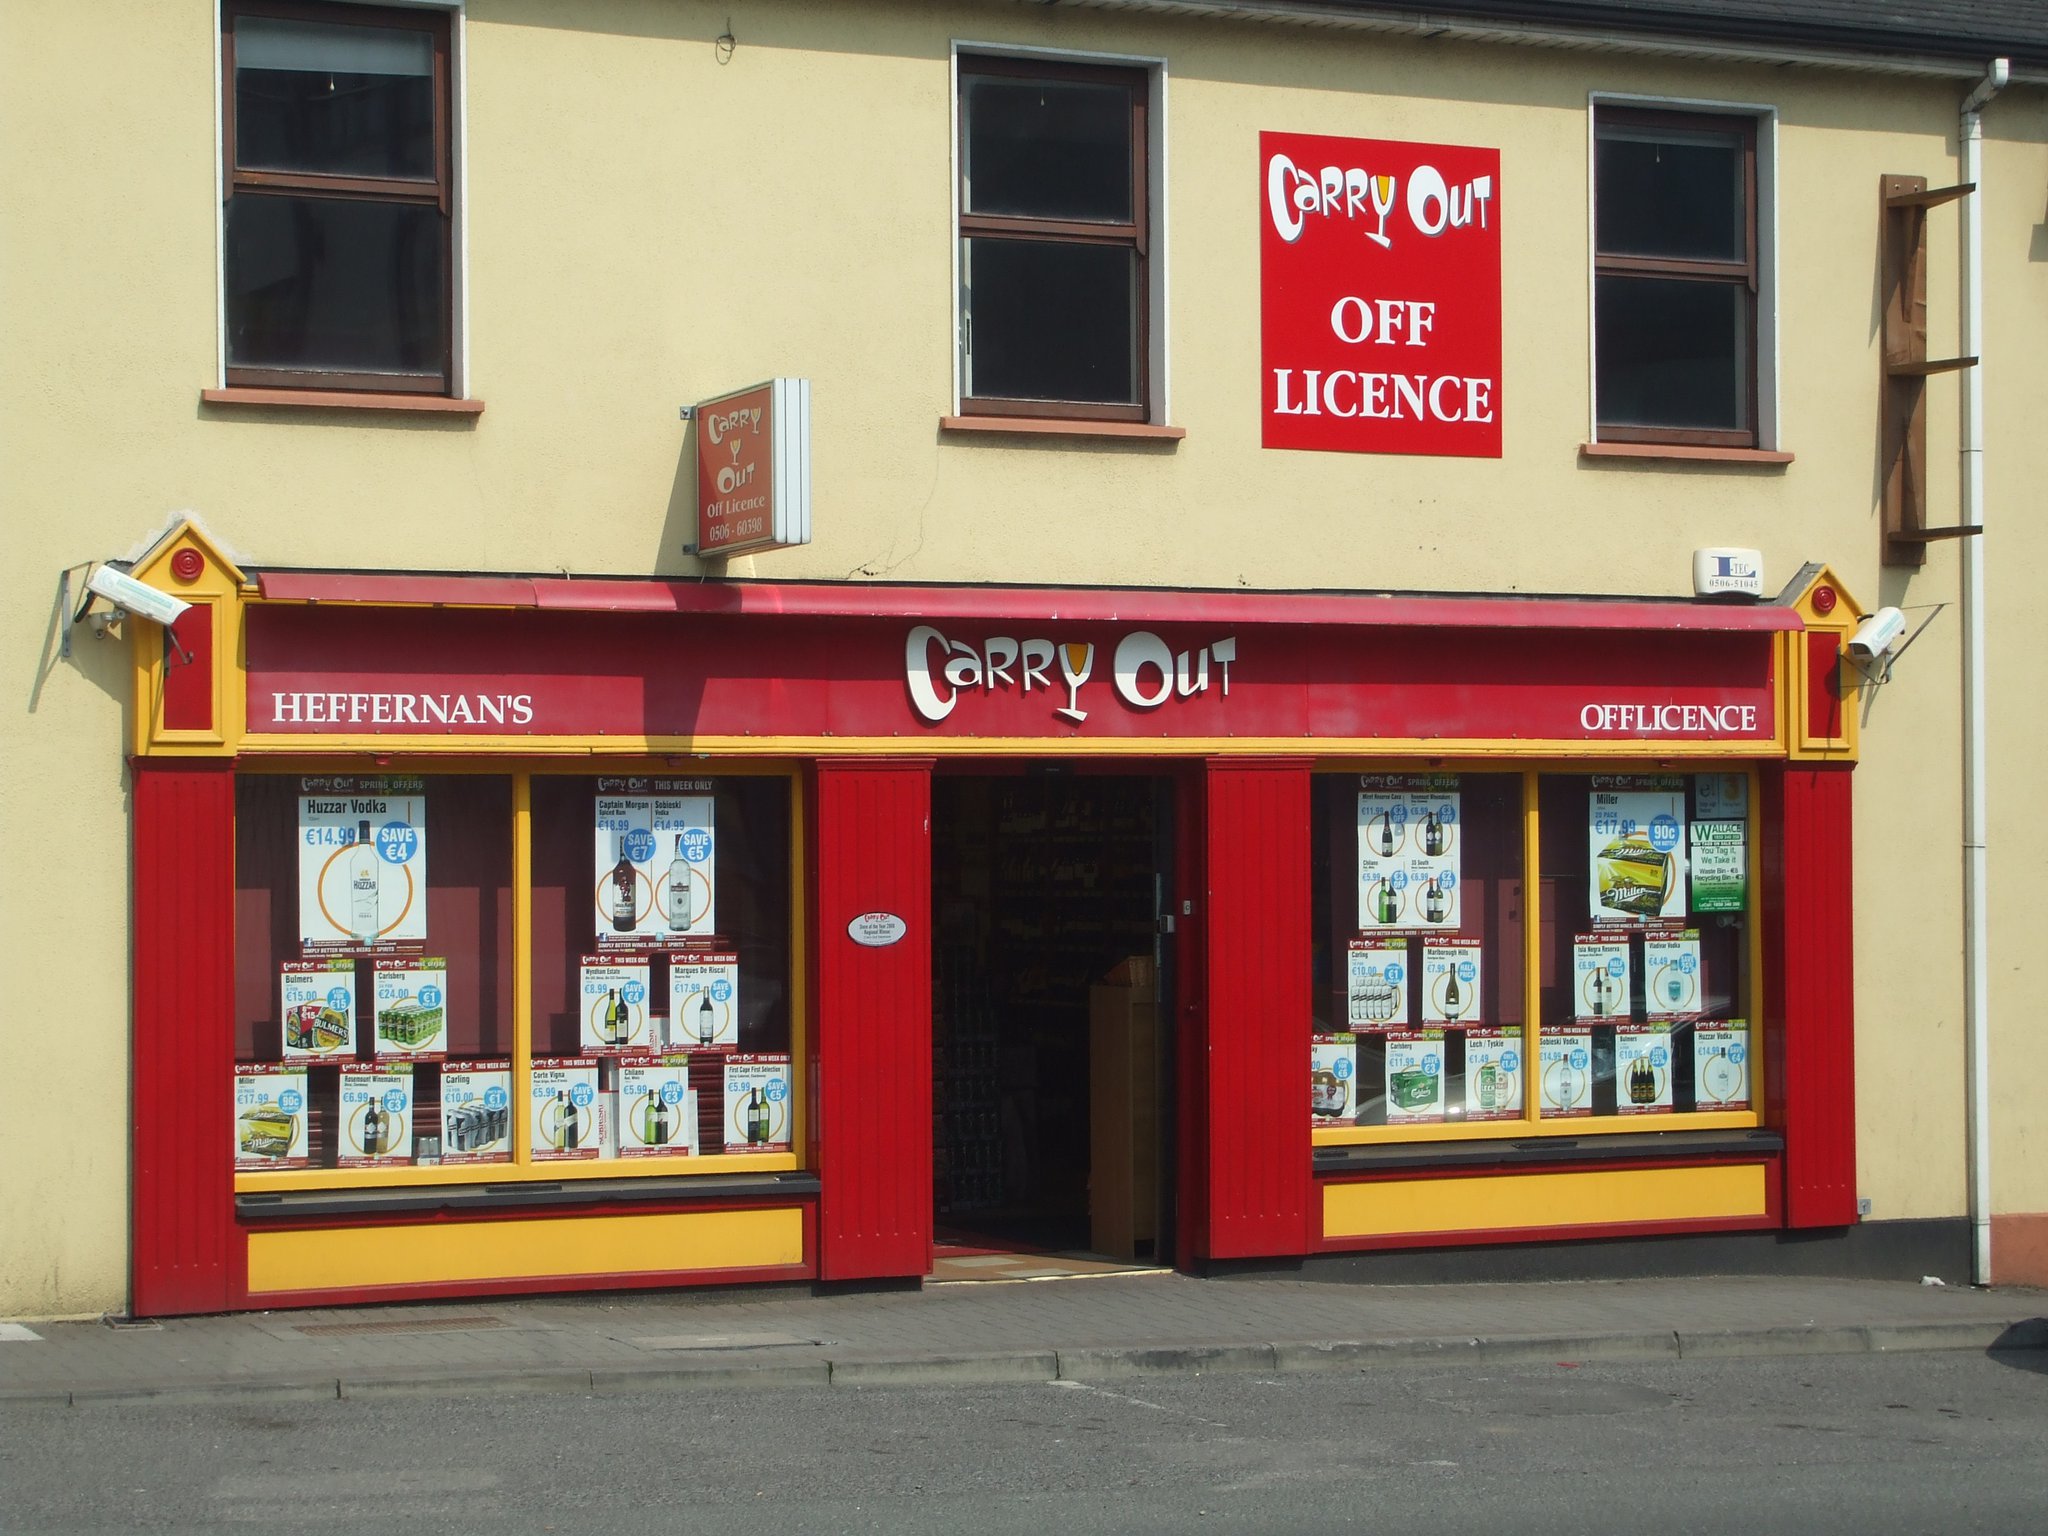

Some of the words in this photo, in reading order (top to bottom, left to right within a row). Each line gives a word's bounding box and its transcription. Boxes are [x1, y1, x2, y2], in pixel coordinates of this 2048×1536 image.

[1330, 295, 1435, 347] OFF
[1273, 368, 1494, 423] LICENCE
[707, 501, 723, 518] Off
[726, 496, 765, 515] Licence
[709, 523, 730, 542] 0506
[272, 692, 533, 724] HEFFERNAN'S
[1580, 704, 1757, 731] OFFLICENCE
[360, 780, 388, 789] SPRING
[393, 780, 423, 790] OFFERS
[655, 781, 671, 790] THIS
[673, 781, 693, 790] WEEK
[694, 780, 713, 790] ONLY
[1596, 794, 1618, 804] Miller
[307, 800, 347, 814] Huzzar
[351, 800, 387, 813] Vodka
[599, 800, 624, 810] Captain
[626, 801, 649, 810] Morgan
[655, 800, 681, 809] Sobieski
[1361, 806, 1384, 815] €11.99
[598, 819, 629, 831] €18.99
[654, 819, 685, 831] €14.99
[1595, 819, 1636, 835] €17.99
[306, 827, 356, 846] €14.99
[381, 828, 413, 843] SAVE
[1654, 825, 1675, 840] 90c
[1695, 824, 1742, 841] WALLACE
[628, 834, 653, 845] SAVE
[684, 834, 708, 845] SAVE
[386, 843, 408, 860] €4
[632, 846, 648, 860] €7
[687, 846, 704, 860] €5
[1716, 847, 1729, 855] Tag
[1701, 856, 1713, 864] We
[1714, 856, 1730, 864] Take
[1362, 873, 1380, 881] €5.99
[1694, 874, 1721, 882] Recycling
[353, 880, 377, 890] HUZZAR
[1607, 886, 1647, 903] Miller
[1427, 963, 1446, 973] €7.99
[1578, 961, 1596, 970] €6.99
[378, 972, 405, 980] Carlsberg
[1352, 966, 1377, 976] €10.00
[1388, 968, 1399, 979] €1
[285, 975, 313, 983] Bulmers
[585, 984, 607, 994] €8.99
[625, 984, 643, 992] SAVE
[675, 983, 700, 993] €17.99
[286, 990, 317, 1001] €15.00
[378, 988, 409, 999] €24.00
[423, 992, 436, 1003] €1
[627, 992, 639, 1002] €4
[715, 991, 726, 1000] €5
[330, 1000, 347, 1010] €15
[314, 1018, 349, 1038] BULMERS
[1469, 1040, 1482, 1048] Lech
[1487, 1040, 1504, 1048] Tyskie
[1562, 1037, 1578, 1045] Vodka
[1698, 1047, 1720, 1055] €14.99
[1390, 1057, 1415, 1067] €11.99
[1469, 1054, 1489, 1064] €1.49
[1502, 1059, 1517, 1068] €1.49
[446, 1075, 470, 1084] Carling
[533, 1071, 548, 1079] Corte
[550, 1072, 565, 1080] Vigna
[624, 1084, 647, 1095] €5.99
[728, 1082, 750, 1092] €5.99
[767, 1082, 785, 1090] SAVE
[343, 1092, 369, 1102] €6.99
[533, 1087, 555, 1097] €5.99
[665, 1092, 678, 1102] €3
[770, 1090, 782, 1100] €5
[238, 1093, 269, 1104] €17.99
[445, 1092, 473, 1103] €10.00
[489, 1094, 500, 1104] €1
[576, 1095, 588, 1105] €3
[388, 1100, 401, 1110] €3
